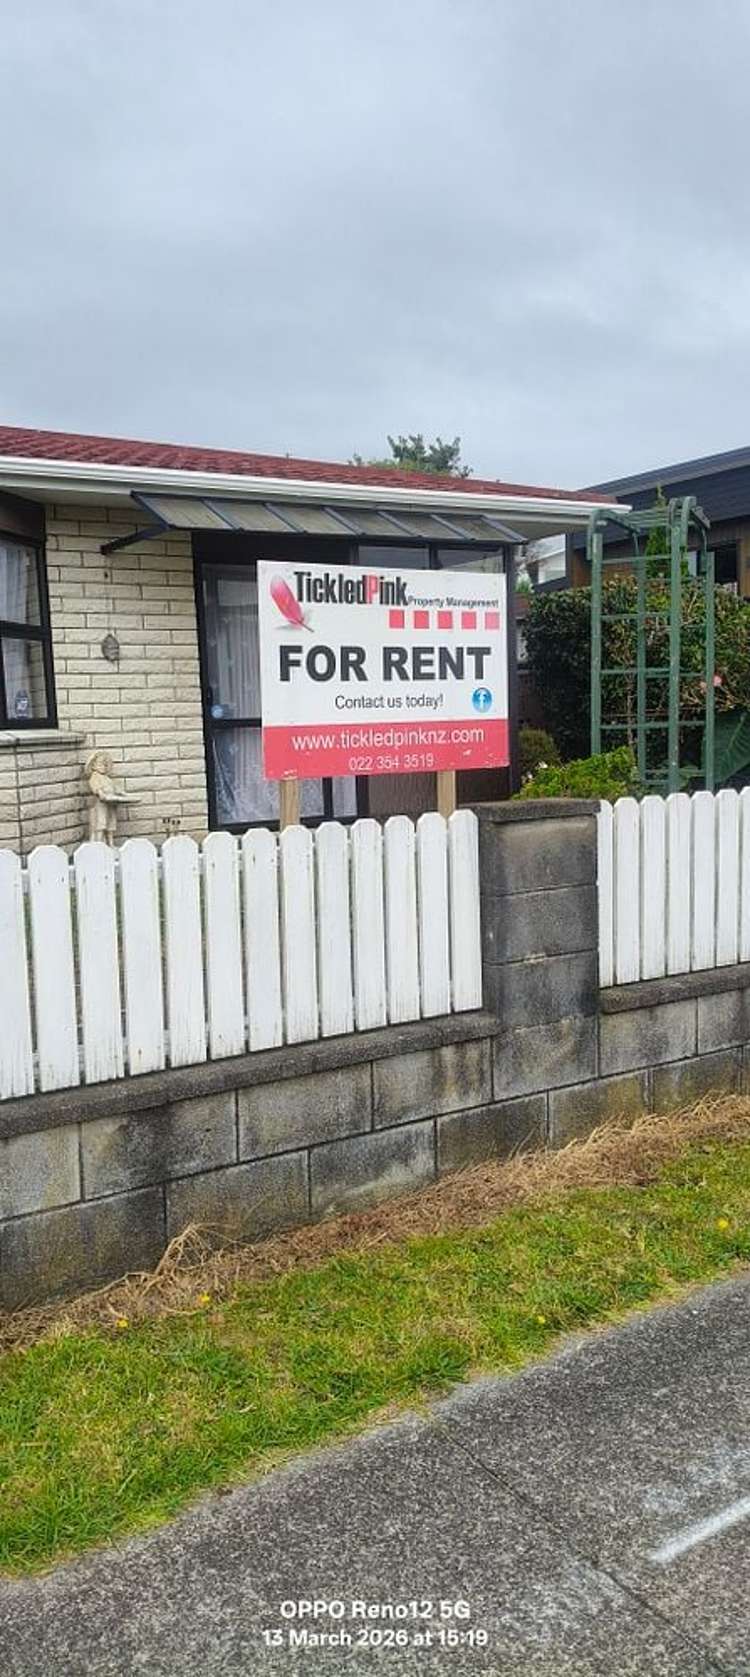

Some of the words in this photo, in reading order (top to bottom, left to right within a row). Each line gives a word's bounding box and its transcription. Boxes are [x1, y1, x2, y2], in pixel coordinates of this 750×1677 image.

[294, 571, 408, 606] TickledPink
[409, 595, 444, 609] Property
[446, 596, 499, 609] Management
[279, 645, 368, 682] FOR
[382, 646, 491, 681] RENT
[335, 695, 384, 709] Contact
[387, 696, 402, 709] us
[405, 693, 443, 711] today!
[291, 727, 484, 750] www.tickledpinknz.com
[349, 756, 372, 770] 022
[377, 755, 399, 769] 354
[404, 753, 434, 768] 3519
